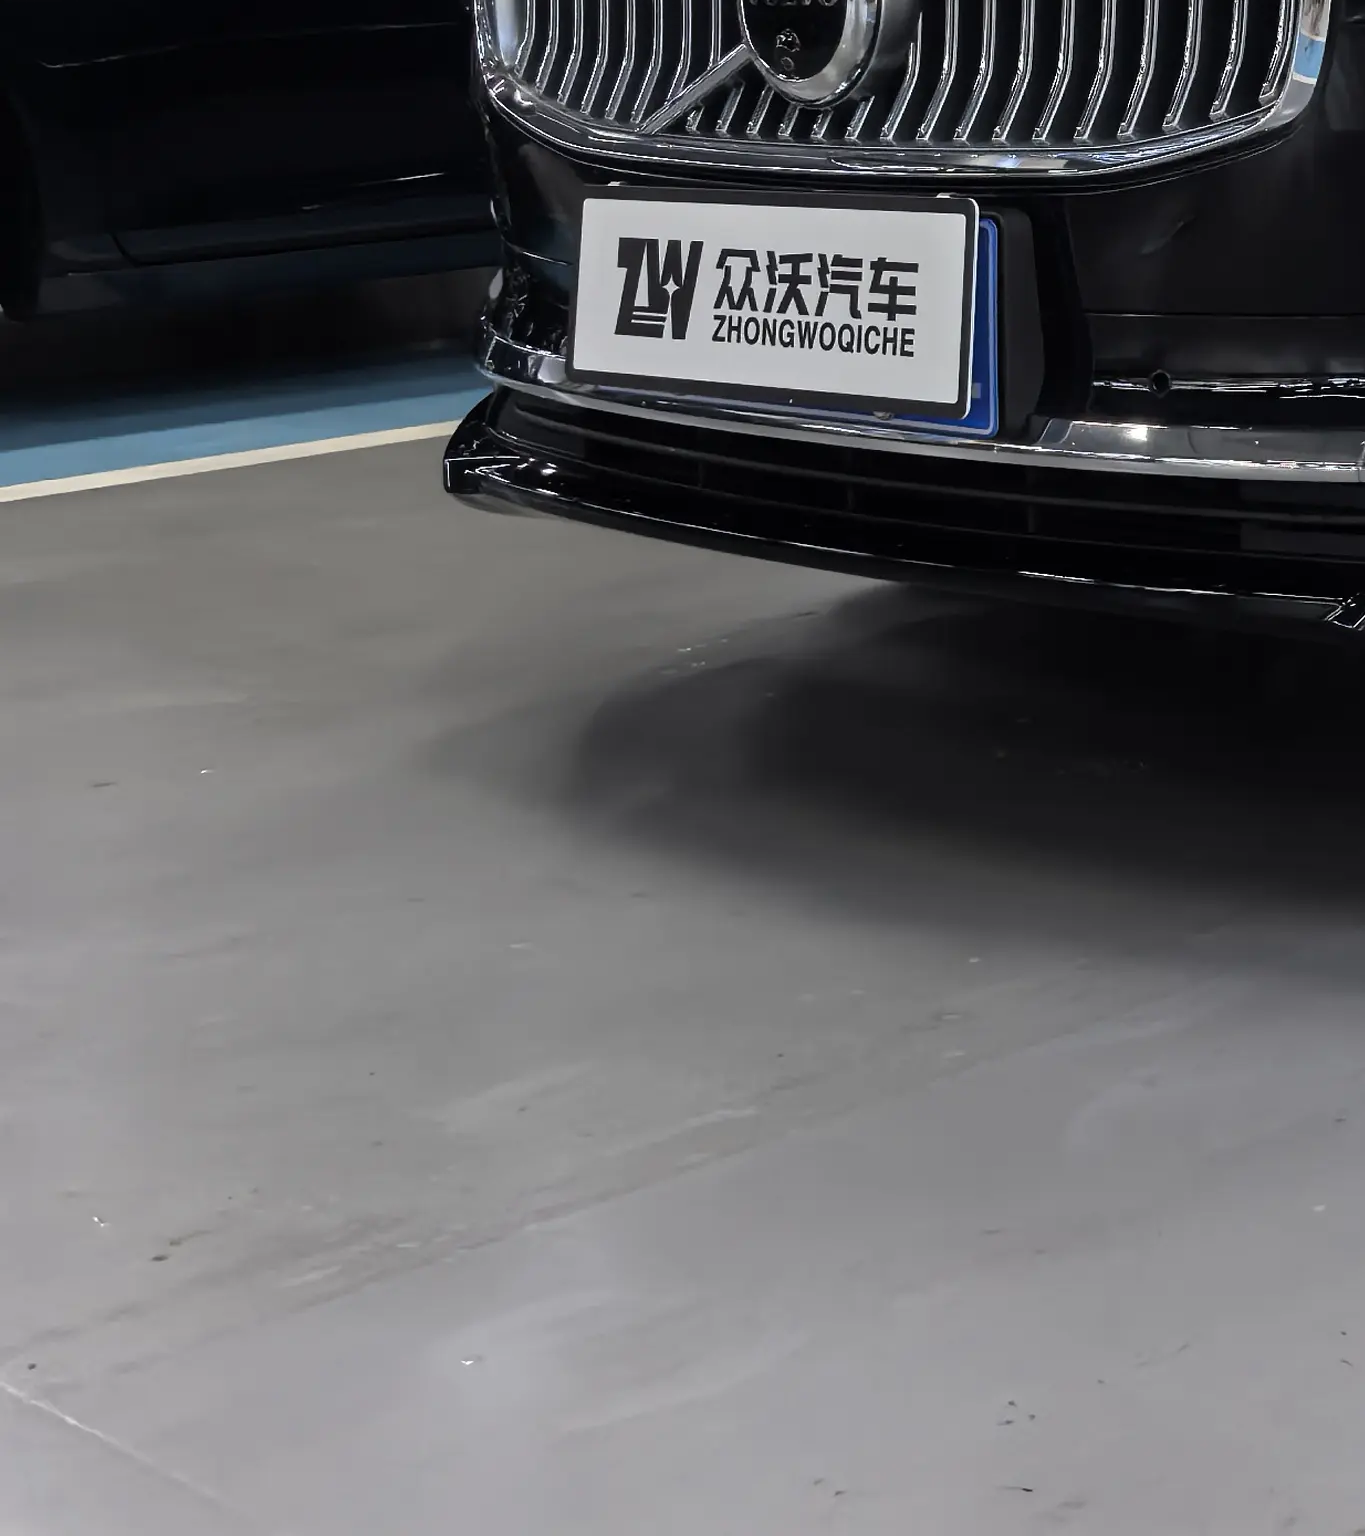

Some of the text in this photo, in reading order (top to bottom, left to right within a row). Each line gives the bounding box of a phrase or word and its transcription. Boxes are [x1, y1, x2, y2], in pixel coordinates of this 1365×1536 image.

[714, 248, 919, 321] 众沃汽车
[711, 314, 916, 358] ZHONGWOQICHE
